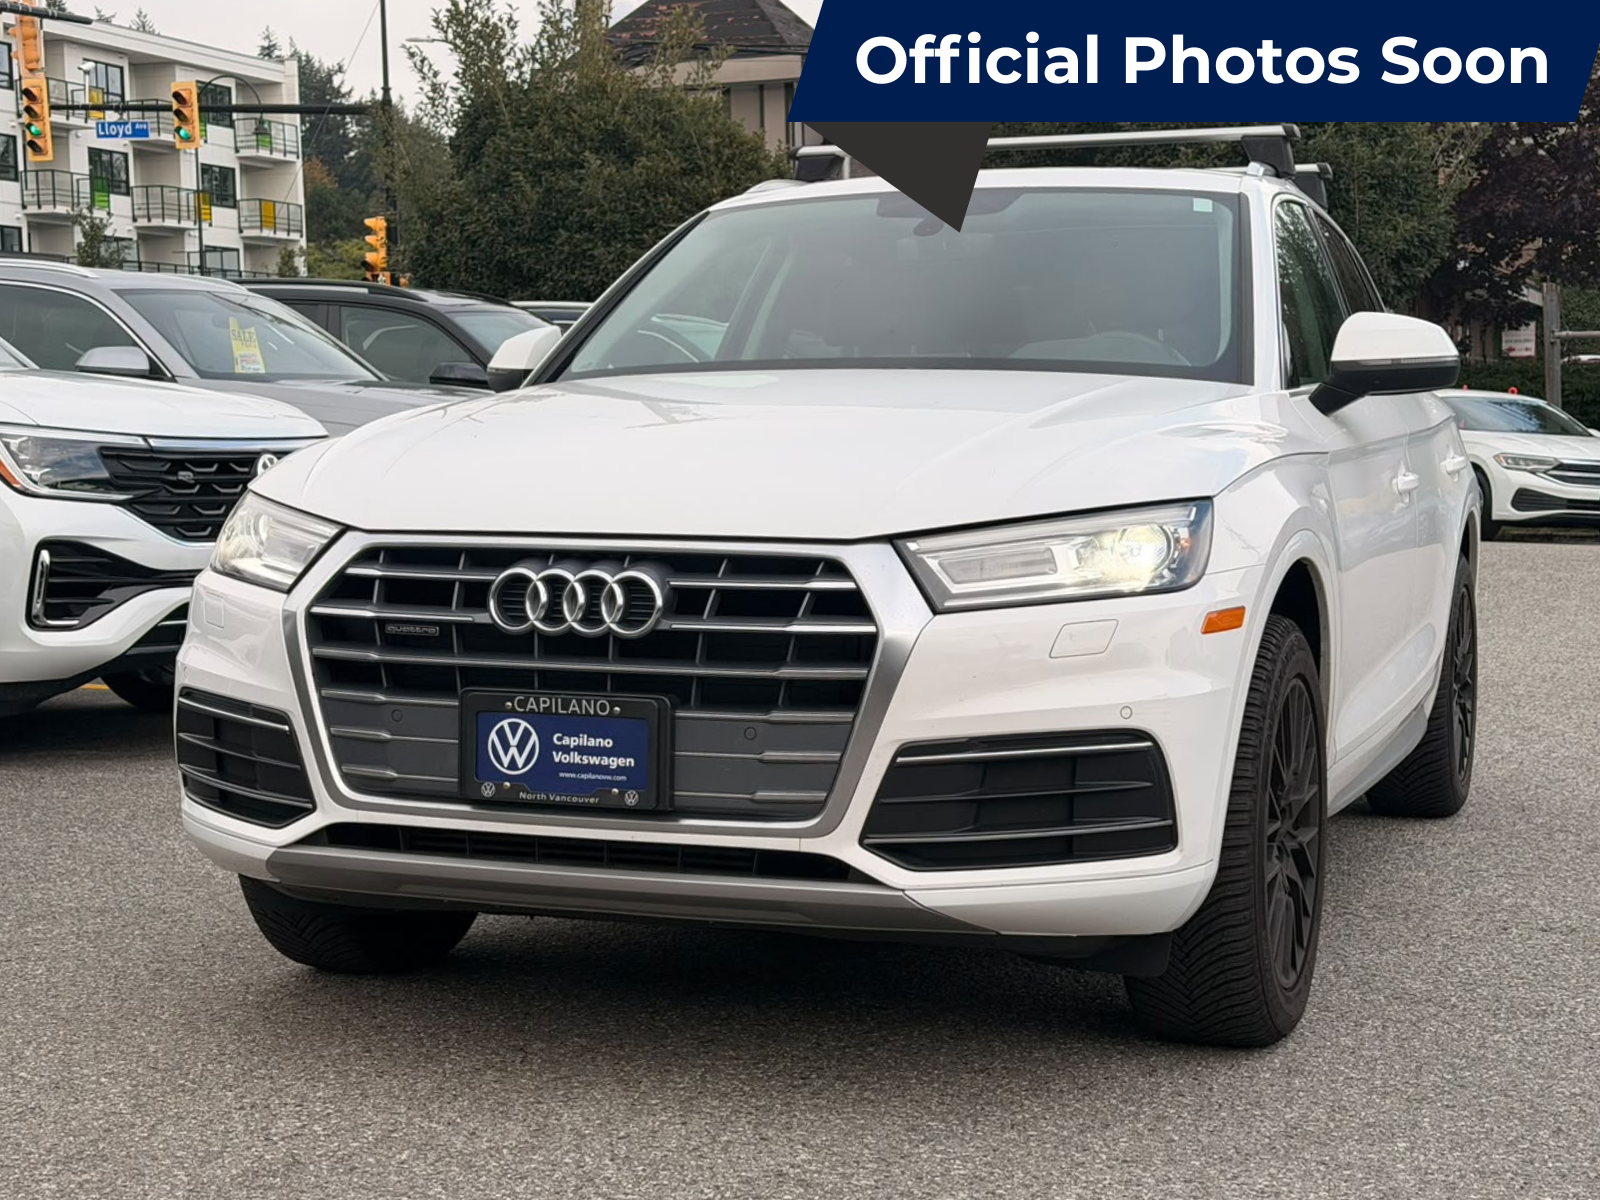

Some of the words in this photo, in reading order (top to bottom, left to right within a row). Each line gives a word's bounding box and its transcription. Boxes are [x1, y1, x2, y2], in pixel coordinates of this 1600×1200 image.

[98, 122, 132, 138] Lloyd
[387, 625, 436, 634] quattro
[514, 696, 610, 716] CAPILANO
[553, 733, 613, 748] Capilano
[552, 751, 635, 769] Volkswagen
[558, 771, 627, 781] www.capilanovw.com
[519, 791, 547, 801] North
[549, 793, 600, 804] Vancouver
